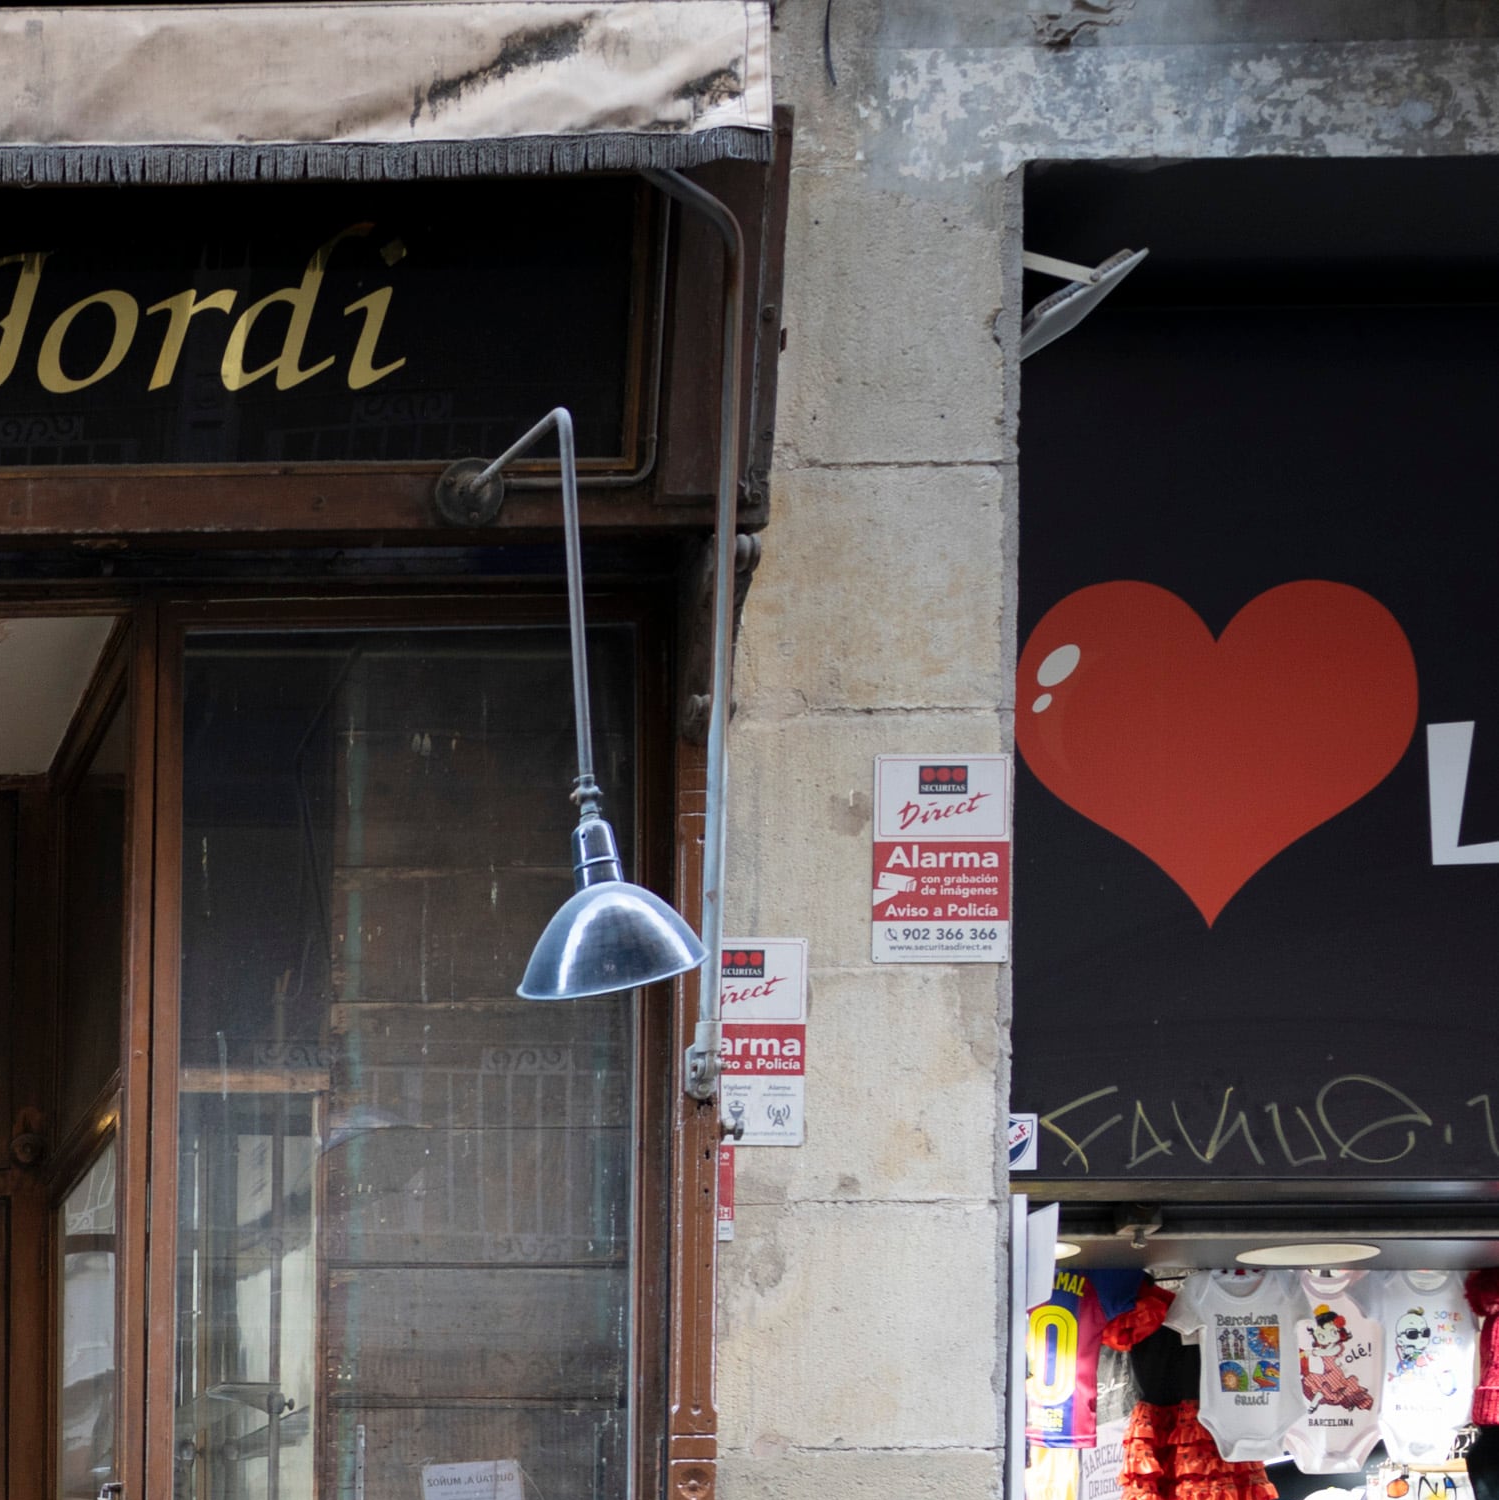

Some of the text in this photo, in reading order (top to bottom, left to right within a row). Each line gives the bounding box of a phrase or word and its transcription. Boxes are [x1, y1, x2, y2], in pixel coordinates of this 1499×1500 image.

[920, 784, 966, 793] SECURITAS
[897, 792, 992, 830] Direct
[886, 844, 999, 869] Alarma
[920, 873, 999, 886] con grabación
[920, 884, 999, 898] de imágenes
[885, 903, 999, 917] Aviso a Policía
[902, 928, 998, 941] 902 366 366
[889, 942, 993, 952] www.securitasdirect.es
[722, 967, 762, 976] ECURITAS
[721, 976, 788, 1006] irect
[721, 1037, 801, 1057] arma
[744, 1060, 753, 1070] a
[756, 1058, 801, 1070] Policía
[1053, 1271, 1085, 1297] MAL
[1308, 1418, 1354, 1427] BARCELONA
